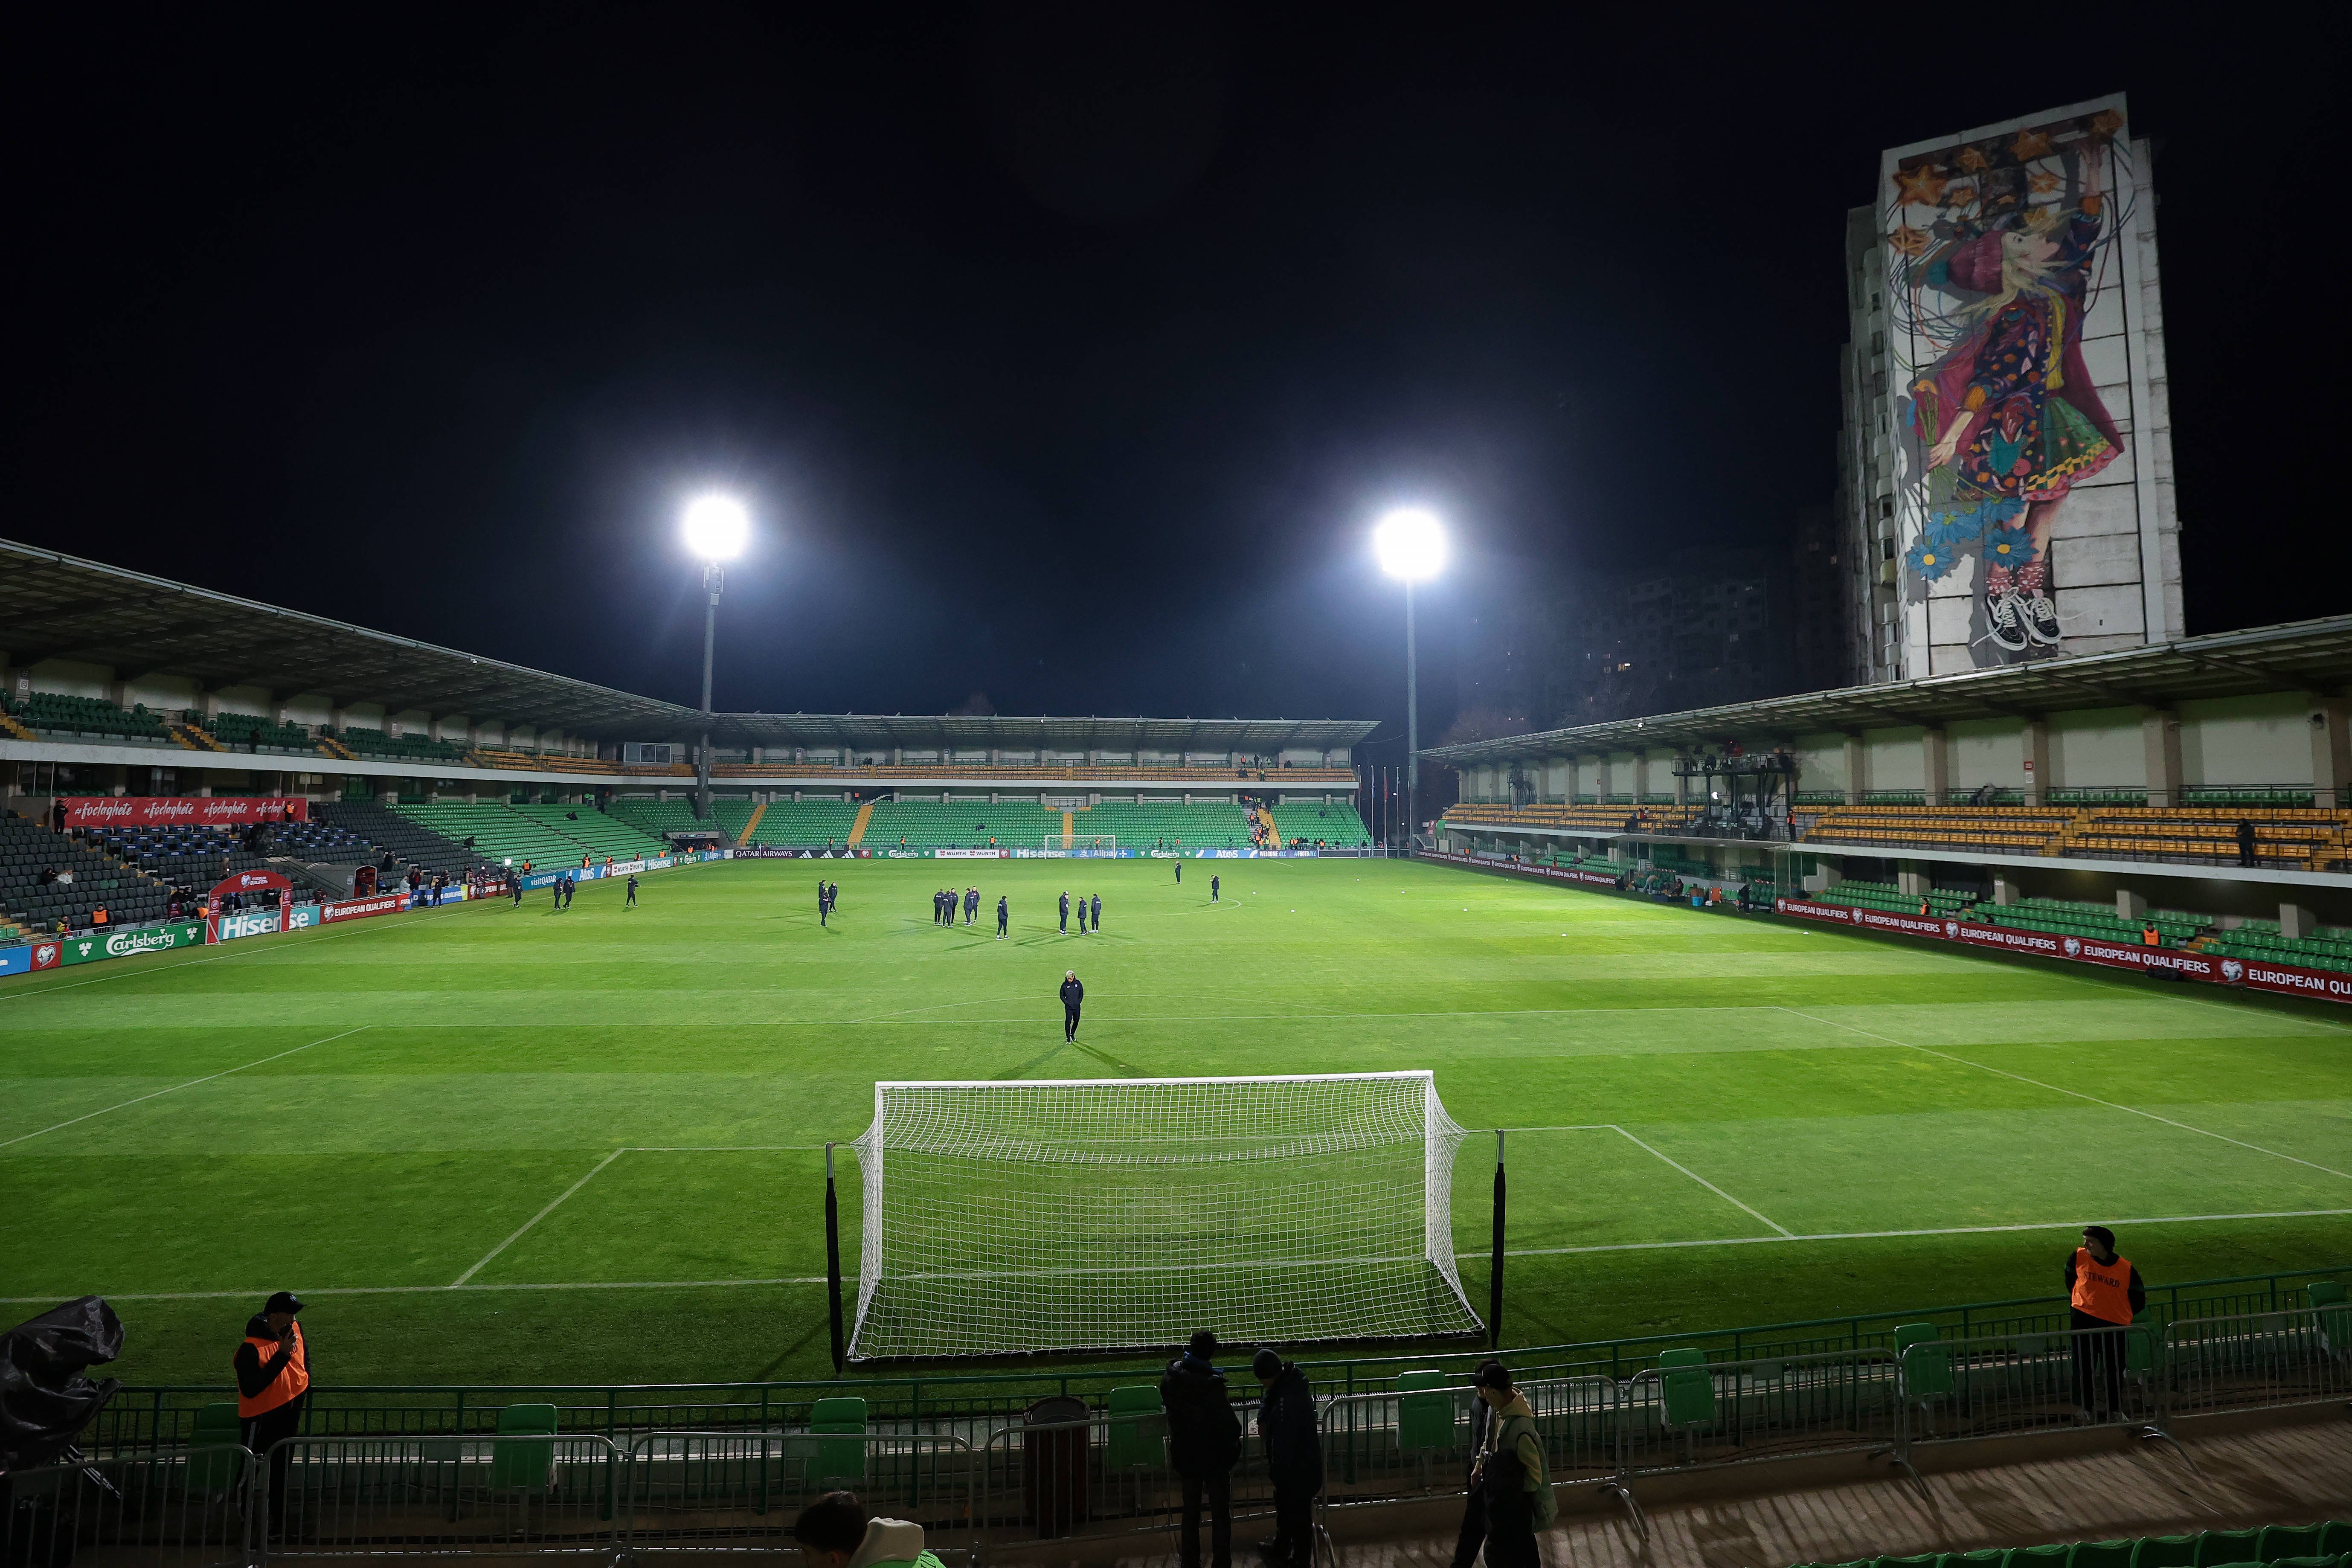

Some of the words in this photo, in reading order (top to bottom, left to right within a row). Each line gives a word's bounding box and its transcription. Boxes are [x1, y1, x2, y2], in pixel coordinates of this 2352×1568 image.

[889, 850, 918, 858] Carlsberg
[1017, 849, 1066, 858] Hisense
[1150, 850, 1180, 858] Carlsberg
[648, 859, 671, 870] Hisense
[334, 905, 365, 916] EUROPEAN
[366, 900, 396, 912] QUALIFIERS
[1787, 903, 1815, 914] EUROPEAN
[1816, 908, 1848, 919] QUALIFIERS
[223, 912, 309, 940] Hisense
[1864, 914, 1899, 926] EUROPEAN
[1900, 920, 1940, 933] QUALIFIERS
[106, 933, 175, 955] Carlsberg
[1961, 928, 2004, 942] EUROPEAN
[2005, 934, 2057, 950] QUALIFIERS
[2084, 945, 2140, 963] EUROPEAN
[2143, 953, 2211, 973] QUALIFIERS
[2248, 969, 2325, 990] EUROPEAN
[2084, 1272, 2120, 1288] STEWARD
